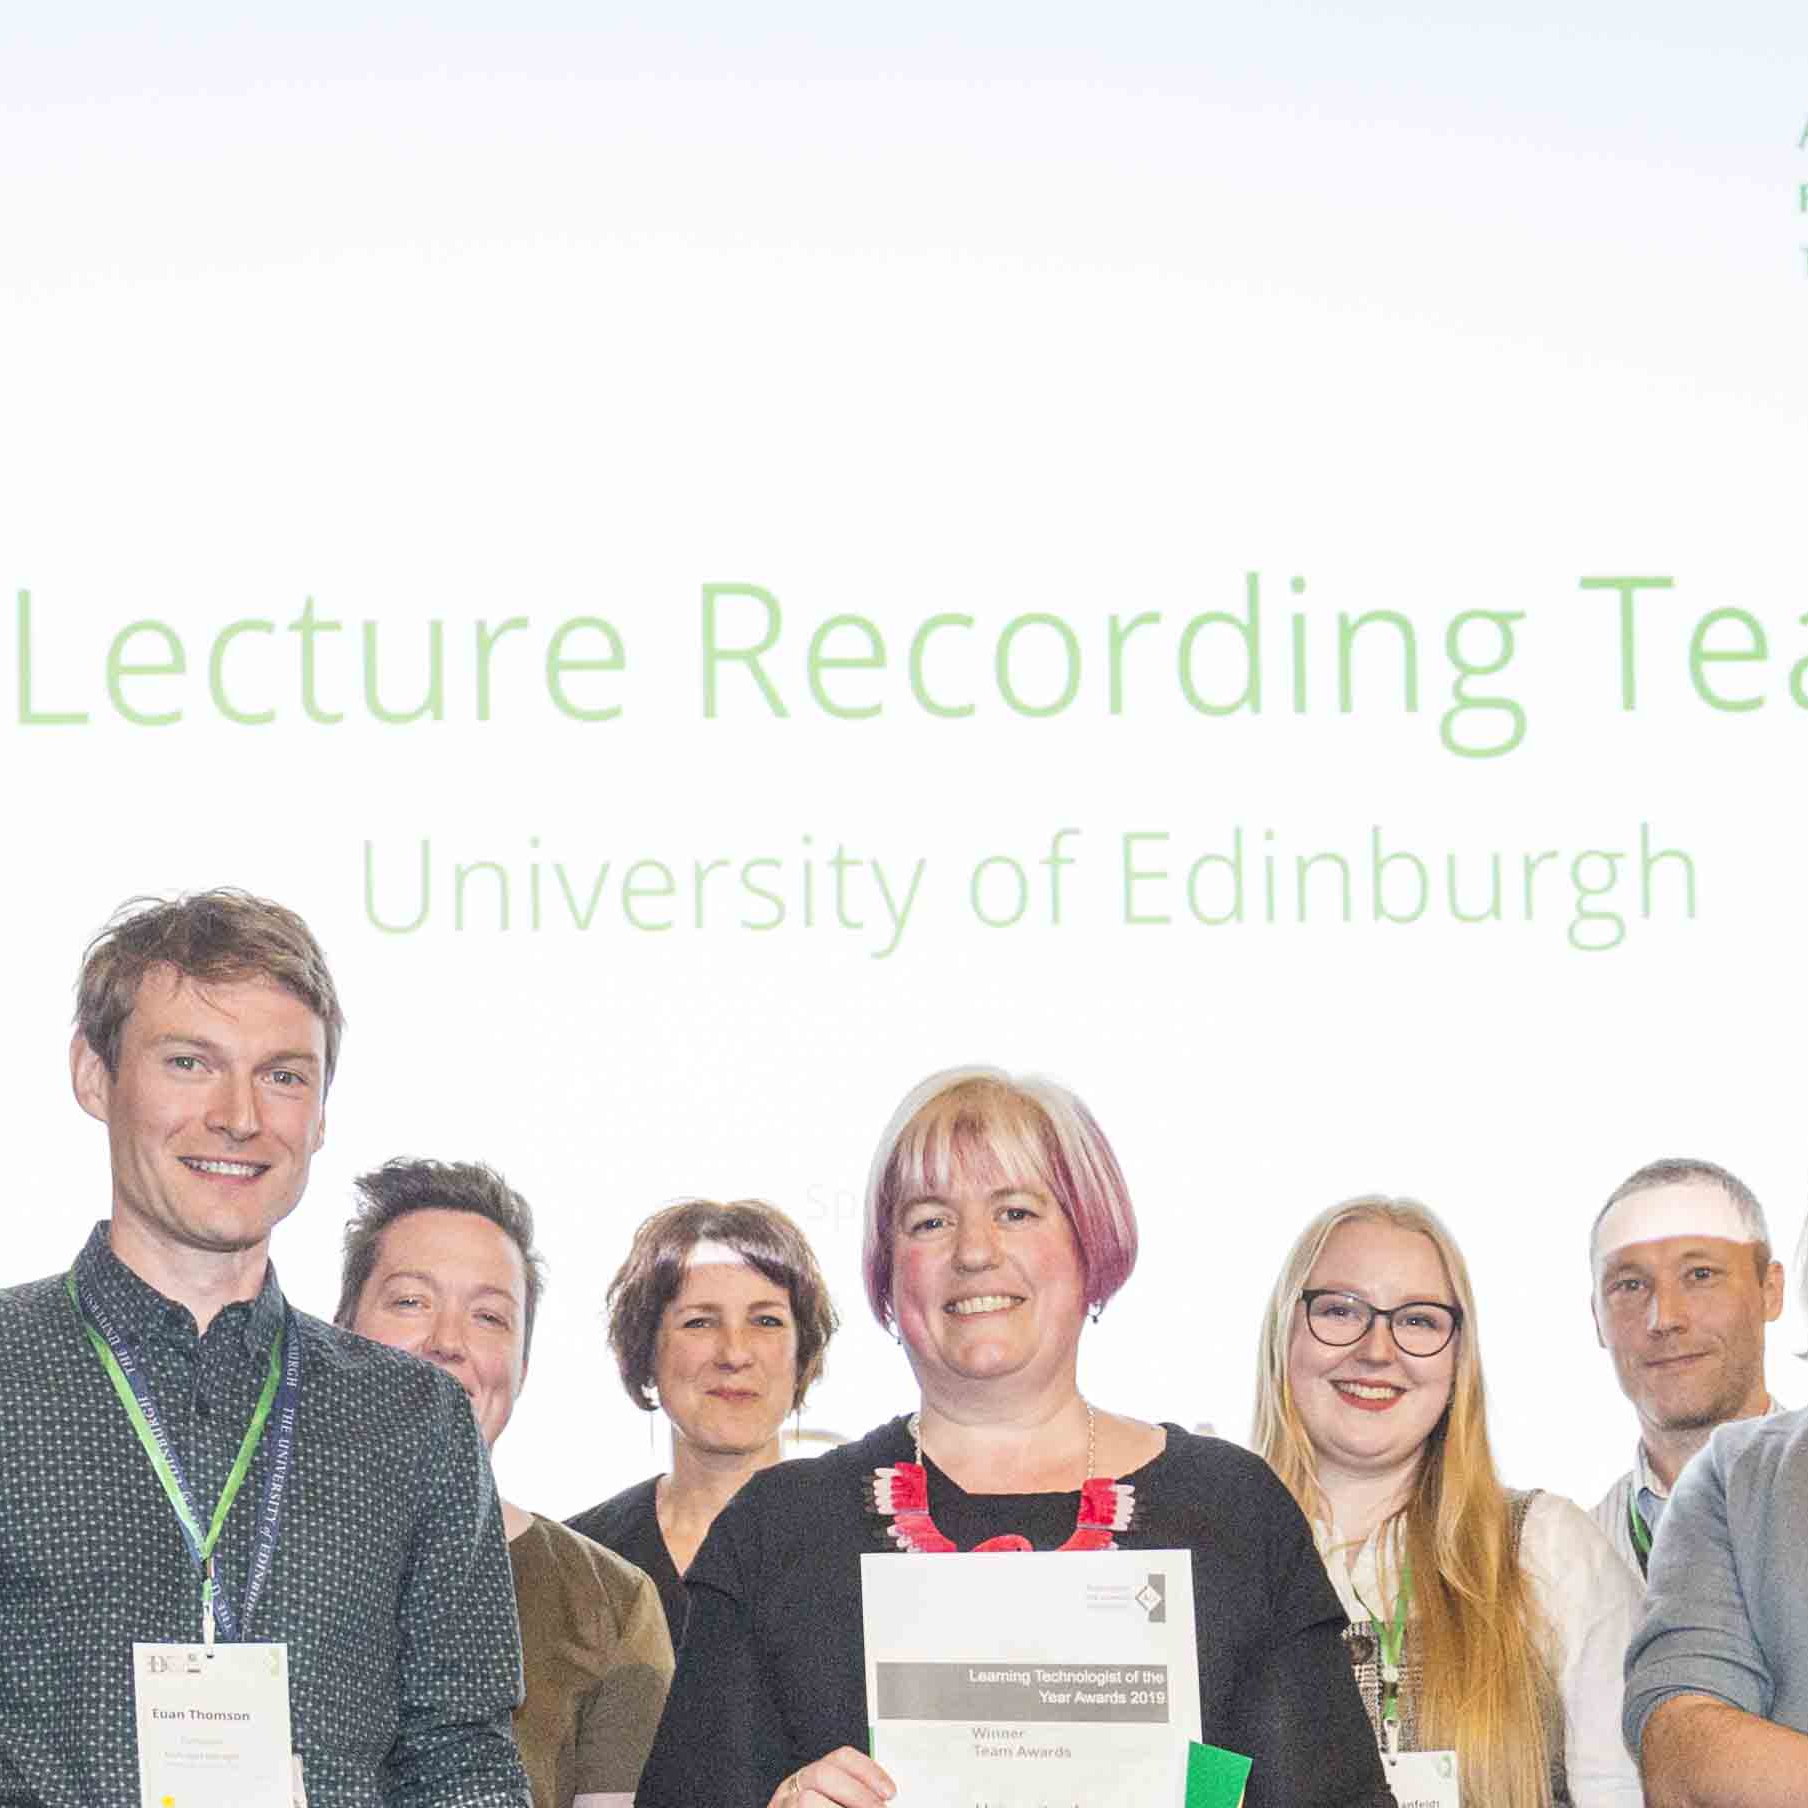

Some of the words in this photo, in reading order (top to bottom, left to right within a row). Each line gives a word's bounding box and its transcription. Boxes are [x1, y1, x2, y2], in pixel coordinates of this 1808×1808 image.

[10, 586, 632, 727] Lecture
[697, 572, 1531, 761] Recording
[359, 826, 929, 960] University
[967, 826, 1084, 926] of
[1115, 818, 1701, 955] Edinburgh
[969, 1669, 1031, 1688] Learning
[1034, 1669, 1120, 1688] Technologist
[1123, 1669, 1138, 1684] of
[1141, 1669, 1164, 1684] the
[1039, 1690, 1070, 1705] Year
[1072, 1690, 1127, 1705] Awards
[1130, 1690, 1166, 1705] 2019
[152, 1708, 185, 1720] Euan
[188, 1708, 251, 1722] Thomson
[972, 1727, 1025, 1740] Winner
[974, 1745, 1010, 1758] Team
[1015, 1745, 1072, 1758] Awards
